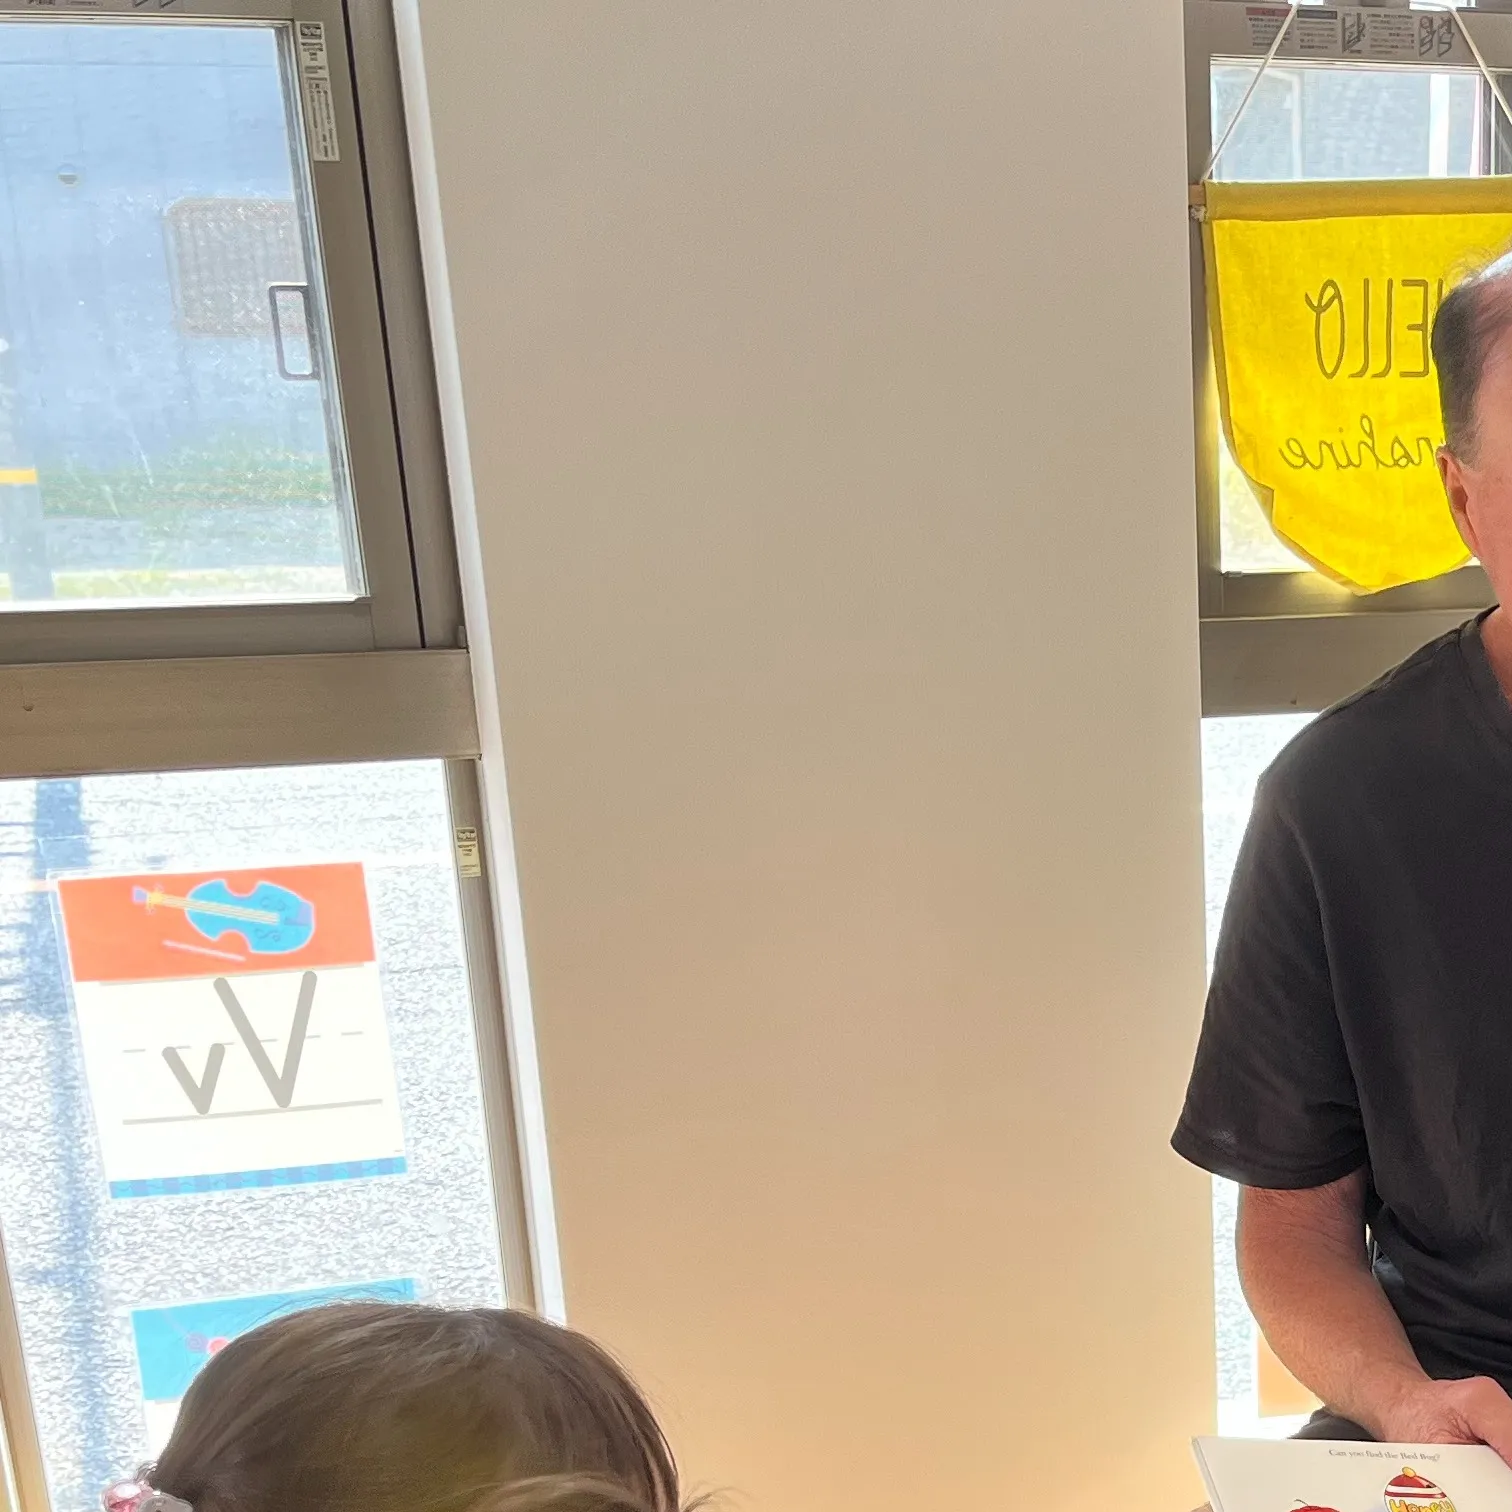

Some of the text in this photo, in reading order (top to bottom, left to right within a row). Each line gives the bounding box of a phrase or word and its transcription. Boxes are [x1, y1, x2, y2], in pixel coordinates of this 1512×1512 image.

[1329, 1449, 1347, 1457] Can
[1349, 1451, 1364, 1459] you
[1366, 1450, 1383, 1458] find
[1385, 1450, 1399, 1459] the
